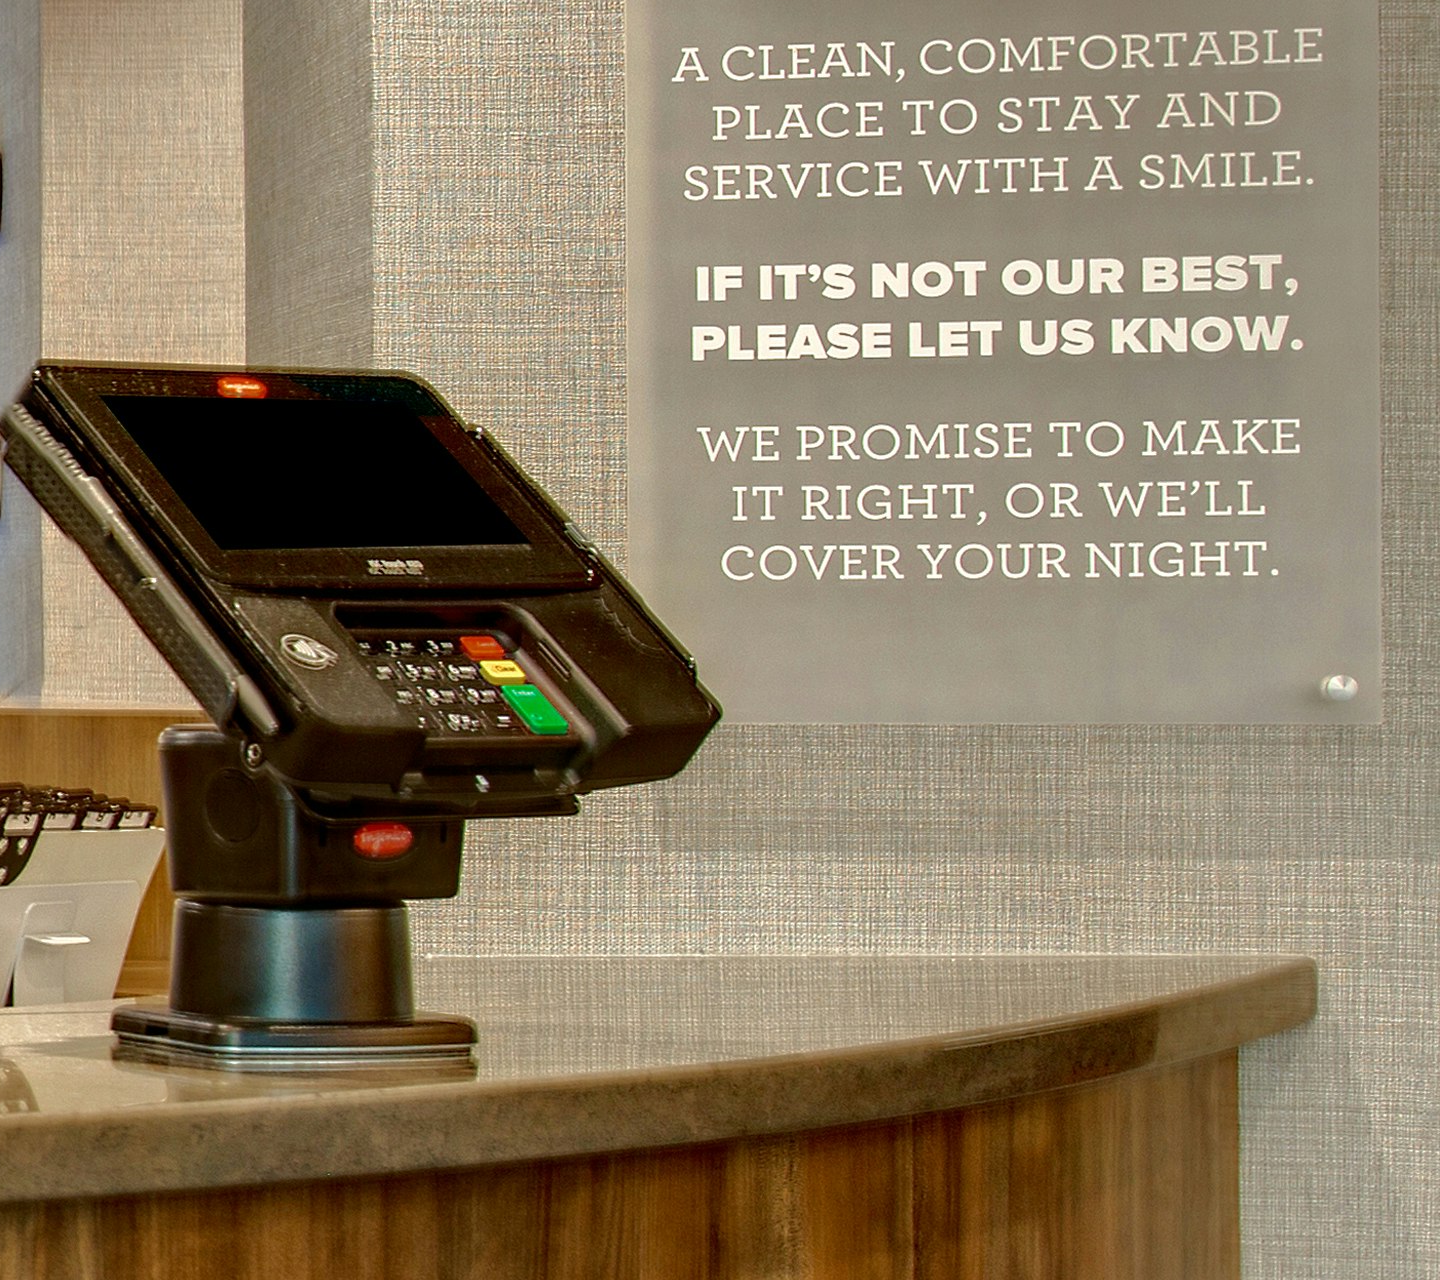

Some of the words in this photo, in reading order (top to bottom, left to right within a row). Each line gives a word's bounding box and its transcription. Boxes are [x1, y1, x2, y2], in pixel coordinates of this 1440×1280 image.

[672, 48, 709, 82] A
[722, 42, 904, 82] CLEAN,
[920, 28, 1322, 74] COMFORTABLE
[713, 102, 883, 140] PLACE
[903, 99, 977, 135] TO
[998, 95, 1140, 132] STAY
[1157, 91, 1281, 128] AND
[684, 162, 902, 200] SERVICE
[918, 157, 1068, 194] WITH
[1084, 156, 1123, 190] A
[1139, 151, 1313, 189] SMILE.
[697, 266, 742, 301] IF
[760, 264, 855, 299] IT'S
[872, 261, 986, 297] NOT
[1002, 259, 1124, 295] OUR
[1143, 255, 1298, 296] BEST,
[693, 323, 891, 360] PLEASE
[909, 321, 1002, 356] LET
[1020, 319, 1094, 355] US
[1112, 316, 1303, 353] KNOW.
[697, 427, 779, 461] WE
[796, 423, 1031, 460] PROMISE
[1049, 422, 1124, 457] TO
[1142, 419, 1300, 455] MAKE
[733, 486, 783, 520] IT
[802, 484, 986, 525] RIGHT,
[1006, 483, 1083, 518] OR
[1098, 481, 1265, 517] WE'LL
[722, 545, 904, 580] COVER
[917, 544, 1070, 578] YOUR
[1085, 542, 1278, 577] NIGHT.
